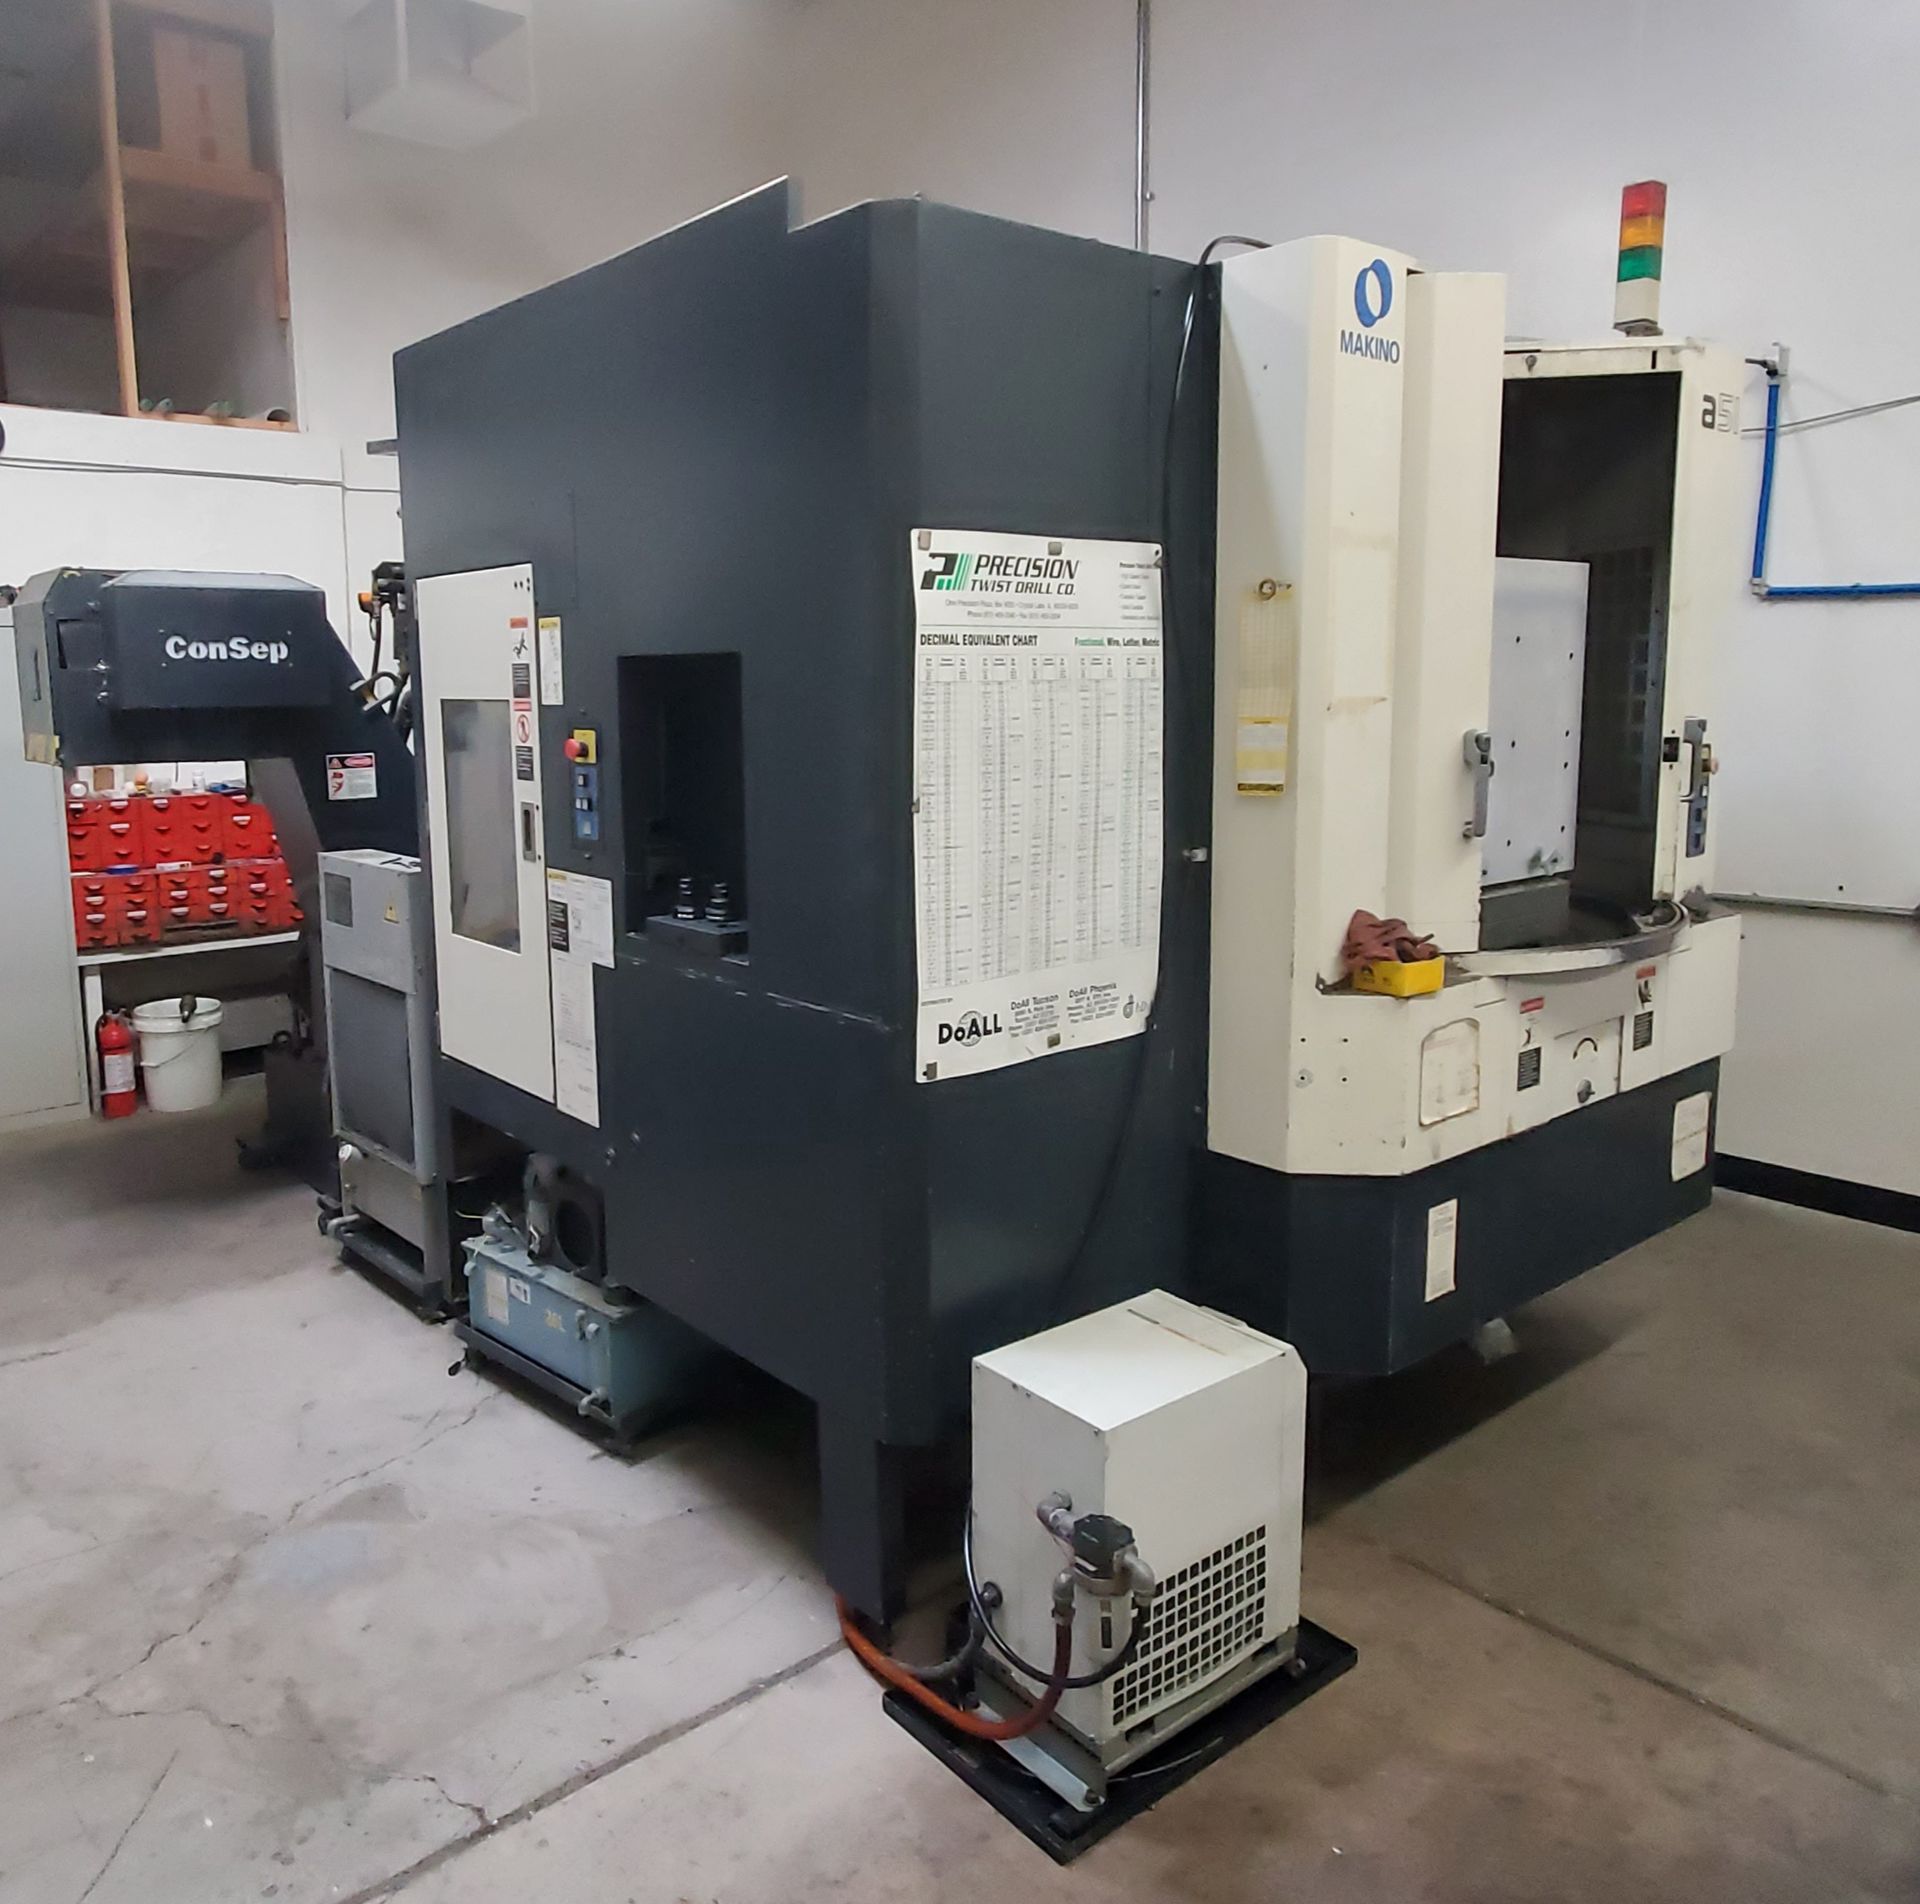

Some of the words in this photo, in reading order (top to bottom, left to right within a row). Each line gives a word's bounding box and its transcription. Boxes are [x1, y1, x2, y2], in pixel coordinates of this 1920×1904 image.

[1340, 329, 1400, 364] MAKINO
[974, 554, 1079, 579] PRECISION
[970, 578, 1013, 593] TWIST
[1015, 581, 1053, 595] DRILL
[1057, 583, 1076, 596] CO.
[165, 635, 289, 664] ConSep
[920, 633, 960, 646] DECIMAL
[962, 634, 1010, 646] EQUIVALENT
[1012, 634, 1038, 646] CHART
[938, 1013, 1003, 1044] DoALL
